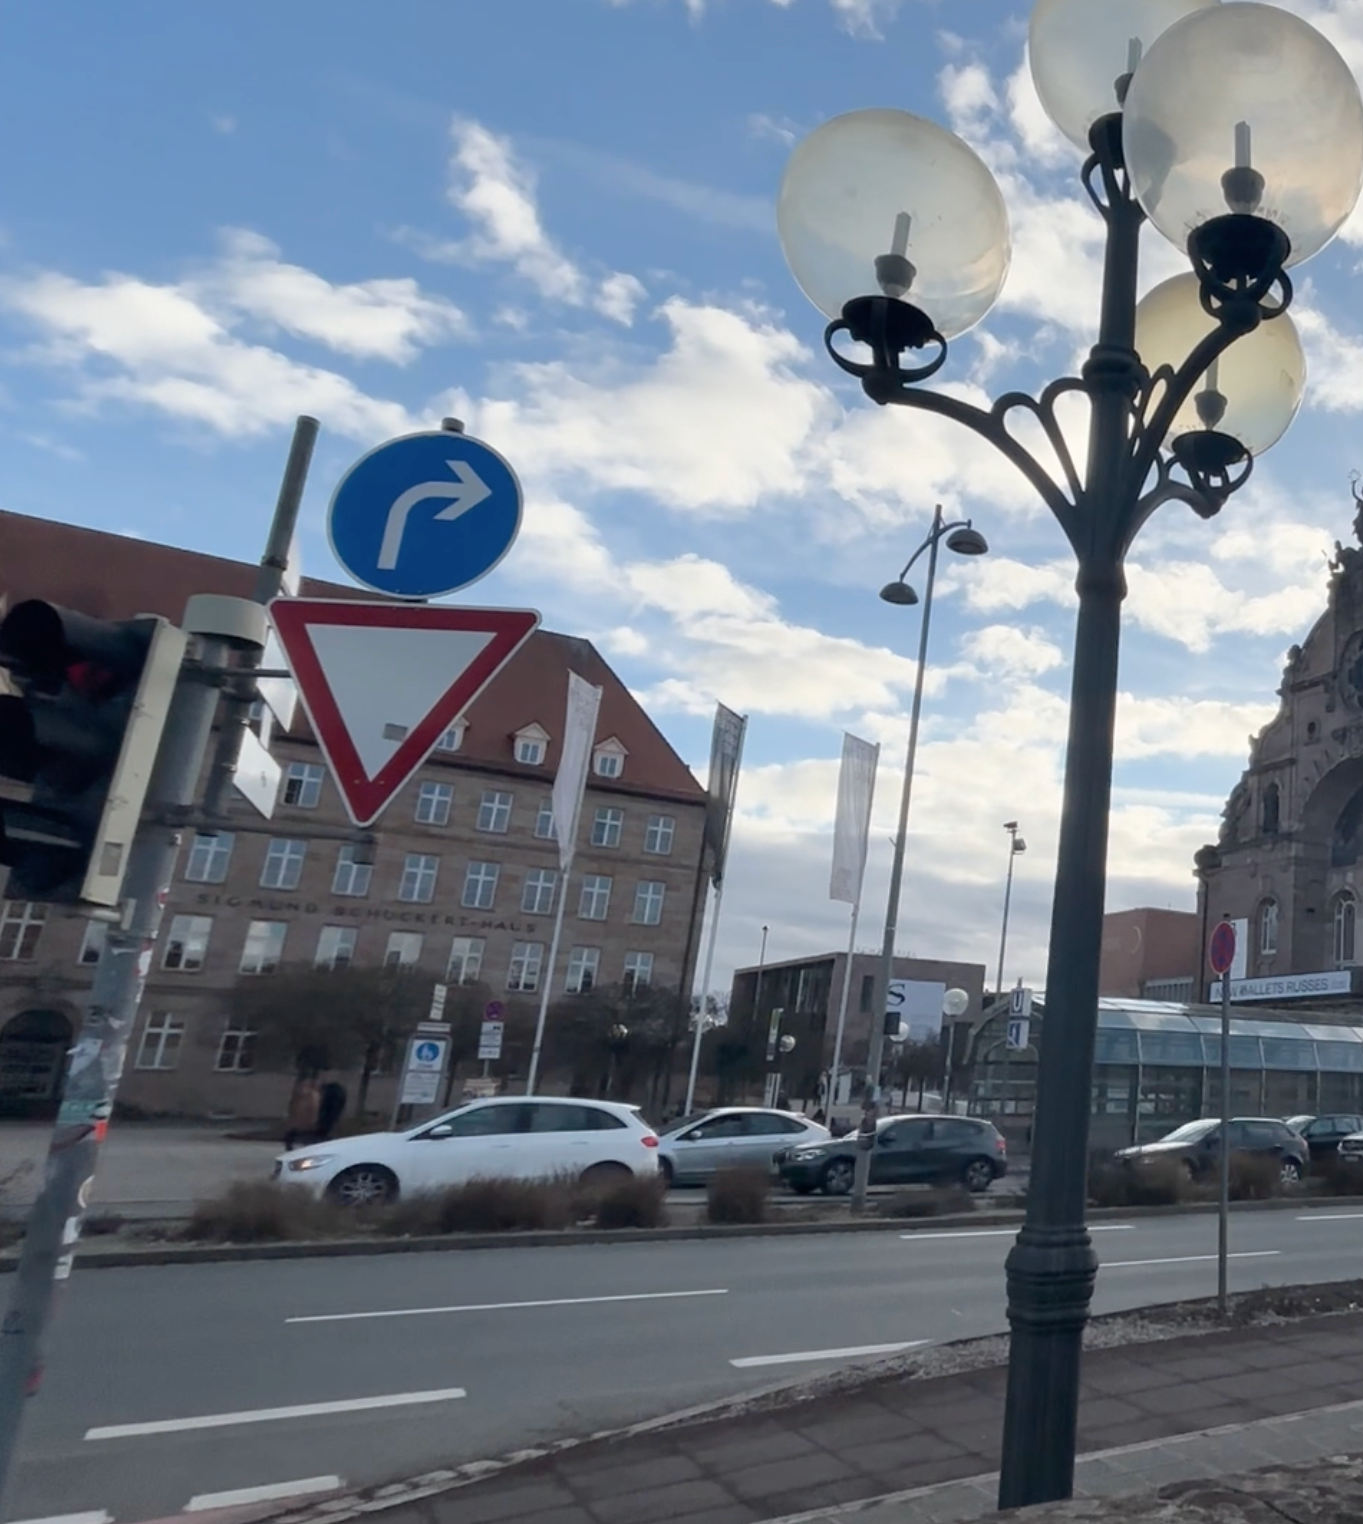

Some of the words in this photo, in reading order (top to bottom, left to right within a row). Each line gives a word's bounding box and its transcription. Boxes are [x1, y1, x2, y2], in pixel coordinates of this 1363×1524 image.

[197, 893, 318, 916] SIGMUND
[1240, 981, 1284, 995] BALLETS
[1286, 977, 1329, 993] RUSSES
[1013, 992, 1022, 1011] U
